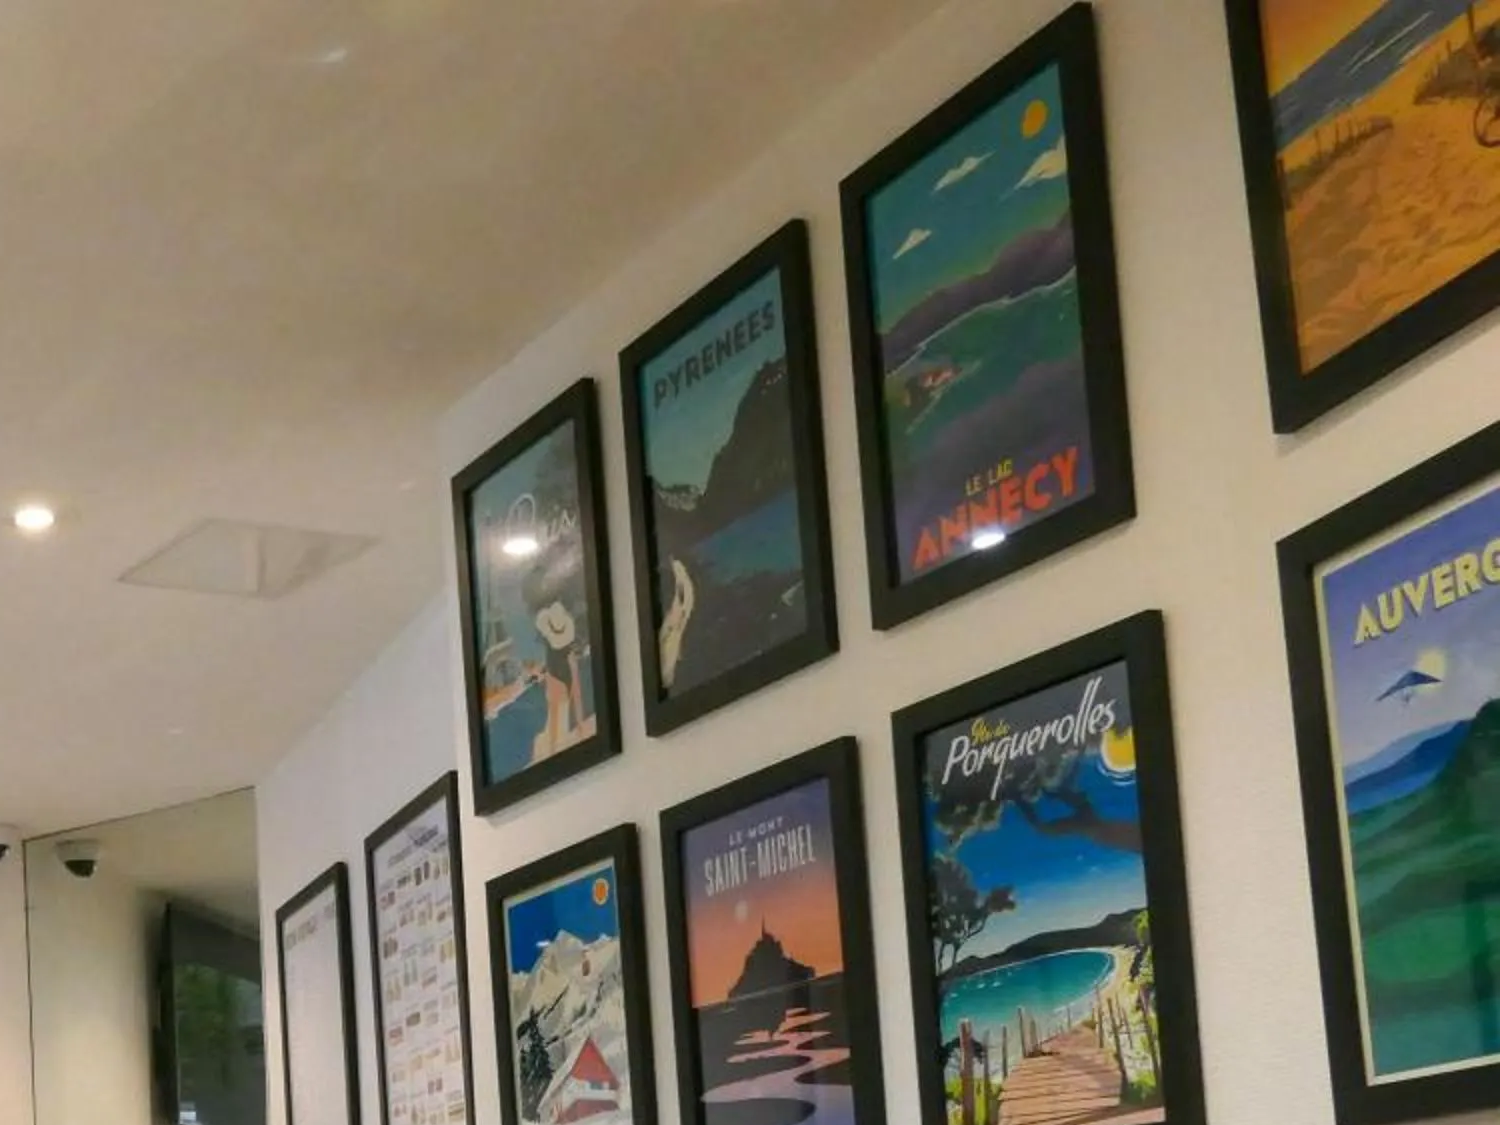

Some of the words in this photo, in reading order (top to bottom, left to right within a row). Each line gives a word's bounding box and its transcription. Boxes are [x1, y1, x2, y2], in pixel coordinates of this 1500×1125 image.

[912, 446, 1078, 573] ANNECY
[965, 473, 982, 496] LE
[988, 458, 1013, 485] LAC
[941, 676, 1116, 800] Porquerolles
[704, 823, 816, 896] SAINT-MICHEL
[747, 816, 783, 839] MONT
